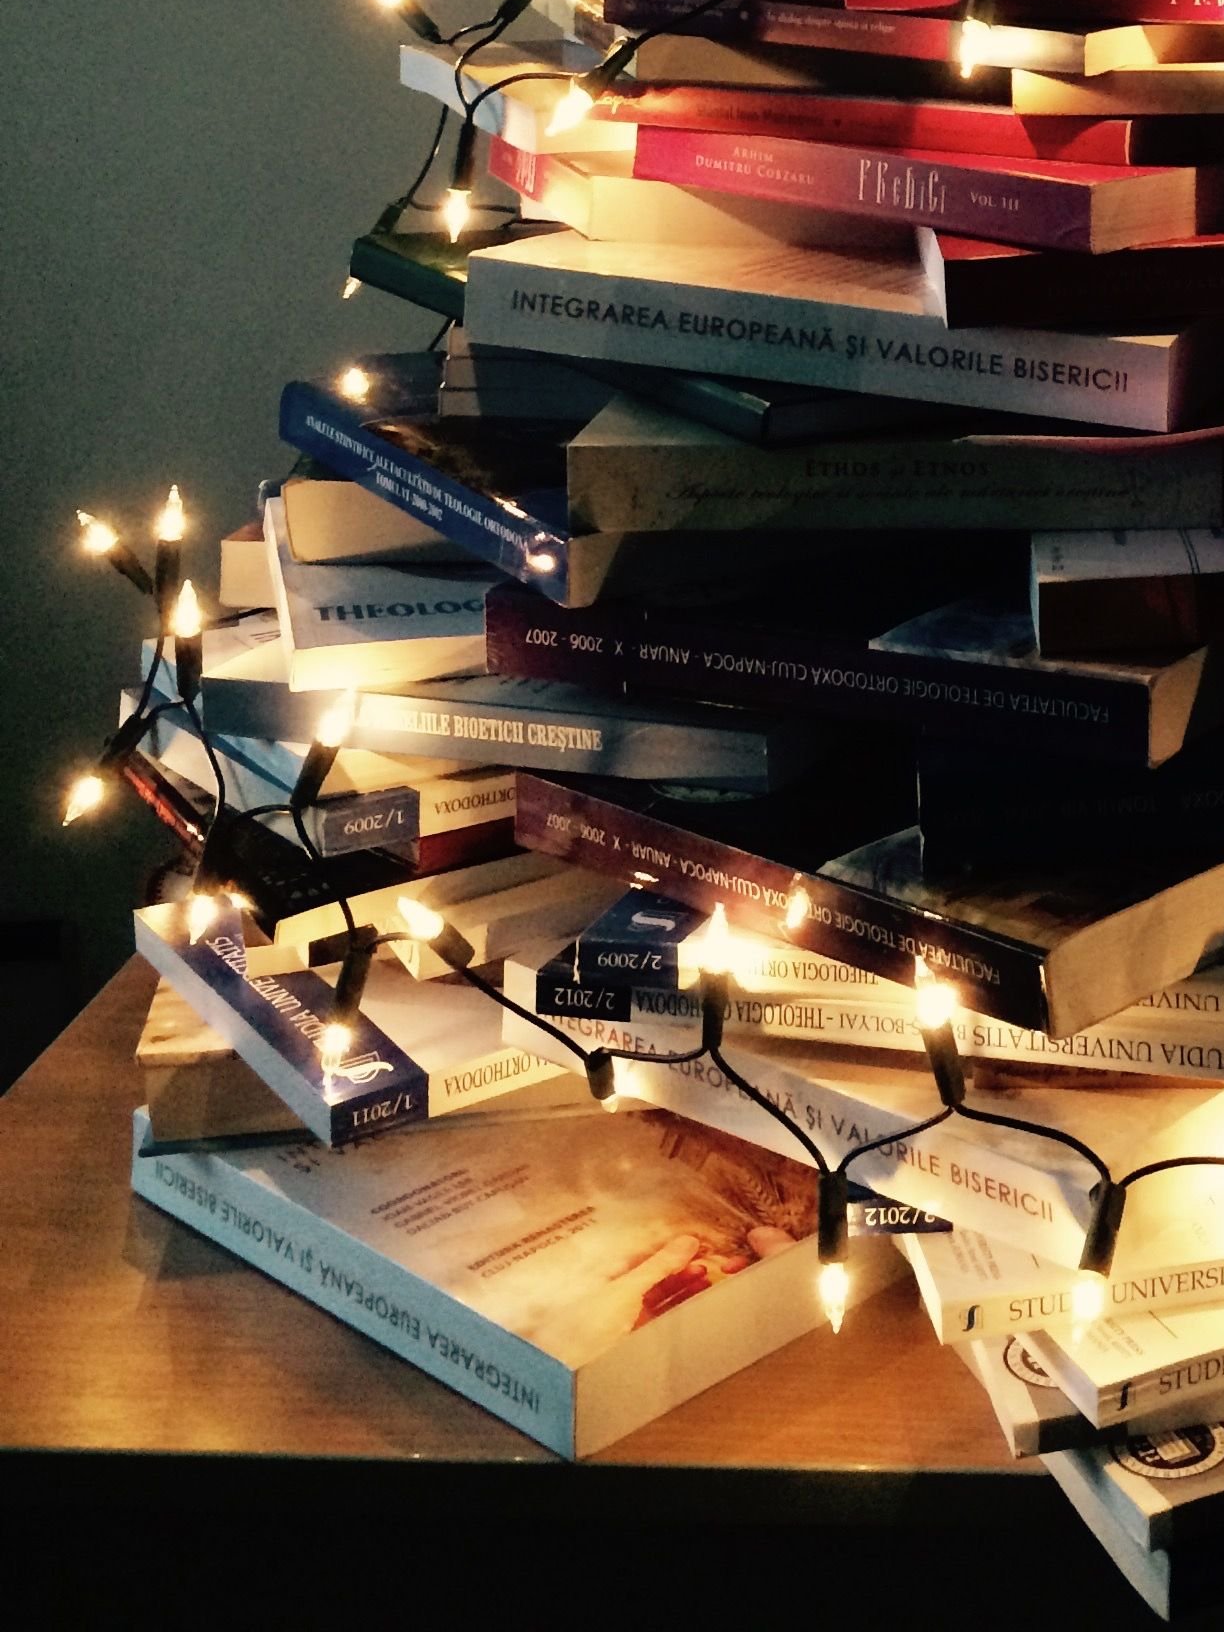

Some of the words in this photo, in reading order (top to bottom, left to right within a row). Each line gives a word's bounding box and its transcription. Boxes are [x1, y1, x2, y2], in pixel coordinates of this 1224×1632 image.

[695, 154, 752, 177] DUMITRU
[758, 163, 816, 186] COBZARU
[511, 288, 669, 331] INTEGRAREA
[679, 311, 836, 353] EUROPEANĂ
[845, 334, 866, 360] ȘI
[876, 337, 1004, 378] VALORILE
[1013, 357, 1129, 394] BISERICII
[525, 628, 559, 647] 2007
[569, 633, 604, 653] 2006
[614, 639, 624, 656] X
[639, 643, 691, 665] ANUAR
[703, 651, 808, 682] CLUJ-NAPOCA
[810, 667, 899, 695] ORTODOXĂ
[902, 678, 981, 706] TEOLOGIE
[983, 689, 1006, 709] DE
[1009, 693, 1110, 724] FACULTATEA
[453, 714, 525, 745] BIOETICII
[526, 722, 604, 753] CREȘTINE
[433, 787, 516, 816] ORTHODOXA
[343, 807, 406, 836] 1/2009
[631, 841, 672, 869] ANUAR
[679, 860, 760, 901] CLUJ-NAPOCA
[763, 887, 833, 925] ORTOXĂ
[834, 914, 897, 950] TEOLOGIE
[898, 935, 917, 959] DE
[597, 950, 663, 972] 2/2009
[919, 939, 1001, 986] FACULTATEA
[553, 987, 616, 1010] 2/2012
[972, 1022, 1153, 1064] UNIVERSITATIS
[443, 1053, 531, 1099] ORTHODOXA
[351, 1091, 413, 1127] 1/2011
[805, 1104, 823, 1130] ȘI
[949, 1163, 1053, 1224] BISERICII
[155, 1161, 218, 1216] BISERICII
[221, 1200, 296, 1260] VALORILE
[864, 1206, 936, 1227] 2/2012
[319, 1249, 421, 1341] EUROPEANĂ
[426, 1326, 541, 1415] INTEGRAREA
